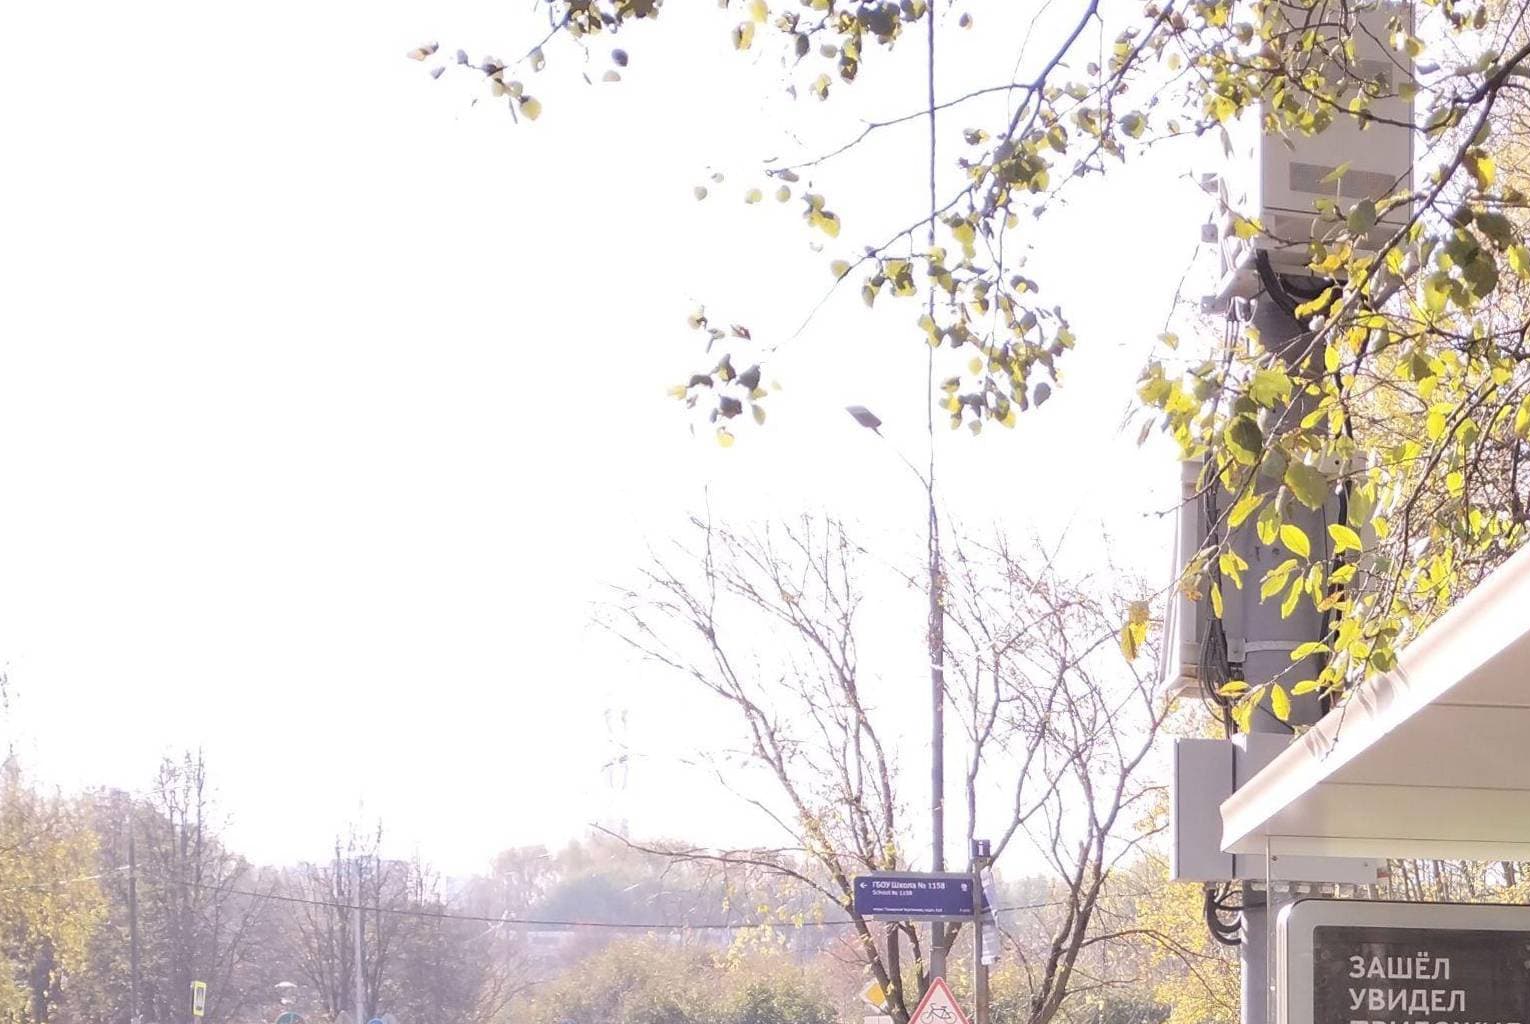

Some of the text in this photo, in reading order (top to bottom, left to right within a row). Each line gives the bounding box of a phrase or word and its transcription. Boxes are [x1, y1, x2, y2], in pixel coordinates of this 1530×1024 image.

[872, 881, 890, 889] ГБОУ
[891, 881, 917, 889] Школа
[1349, 951, 1450, 980] ЗАШЁЛ
[1348, 988, 1466, 1015] УВИДЕЛ
